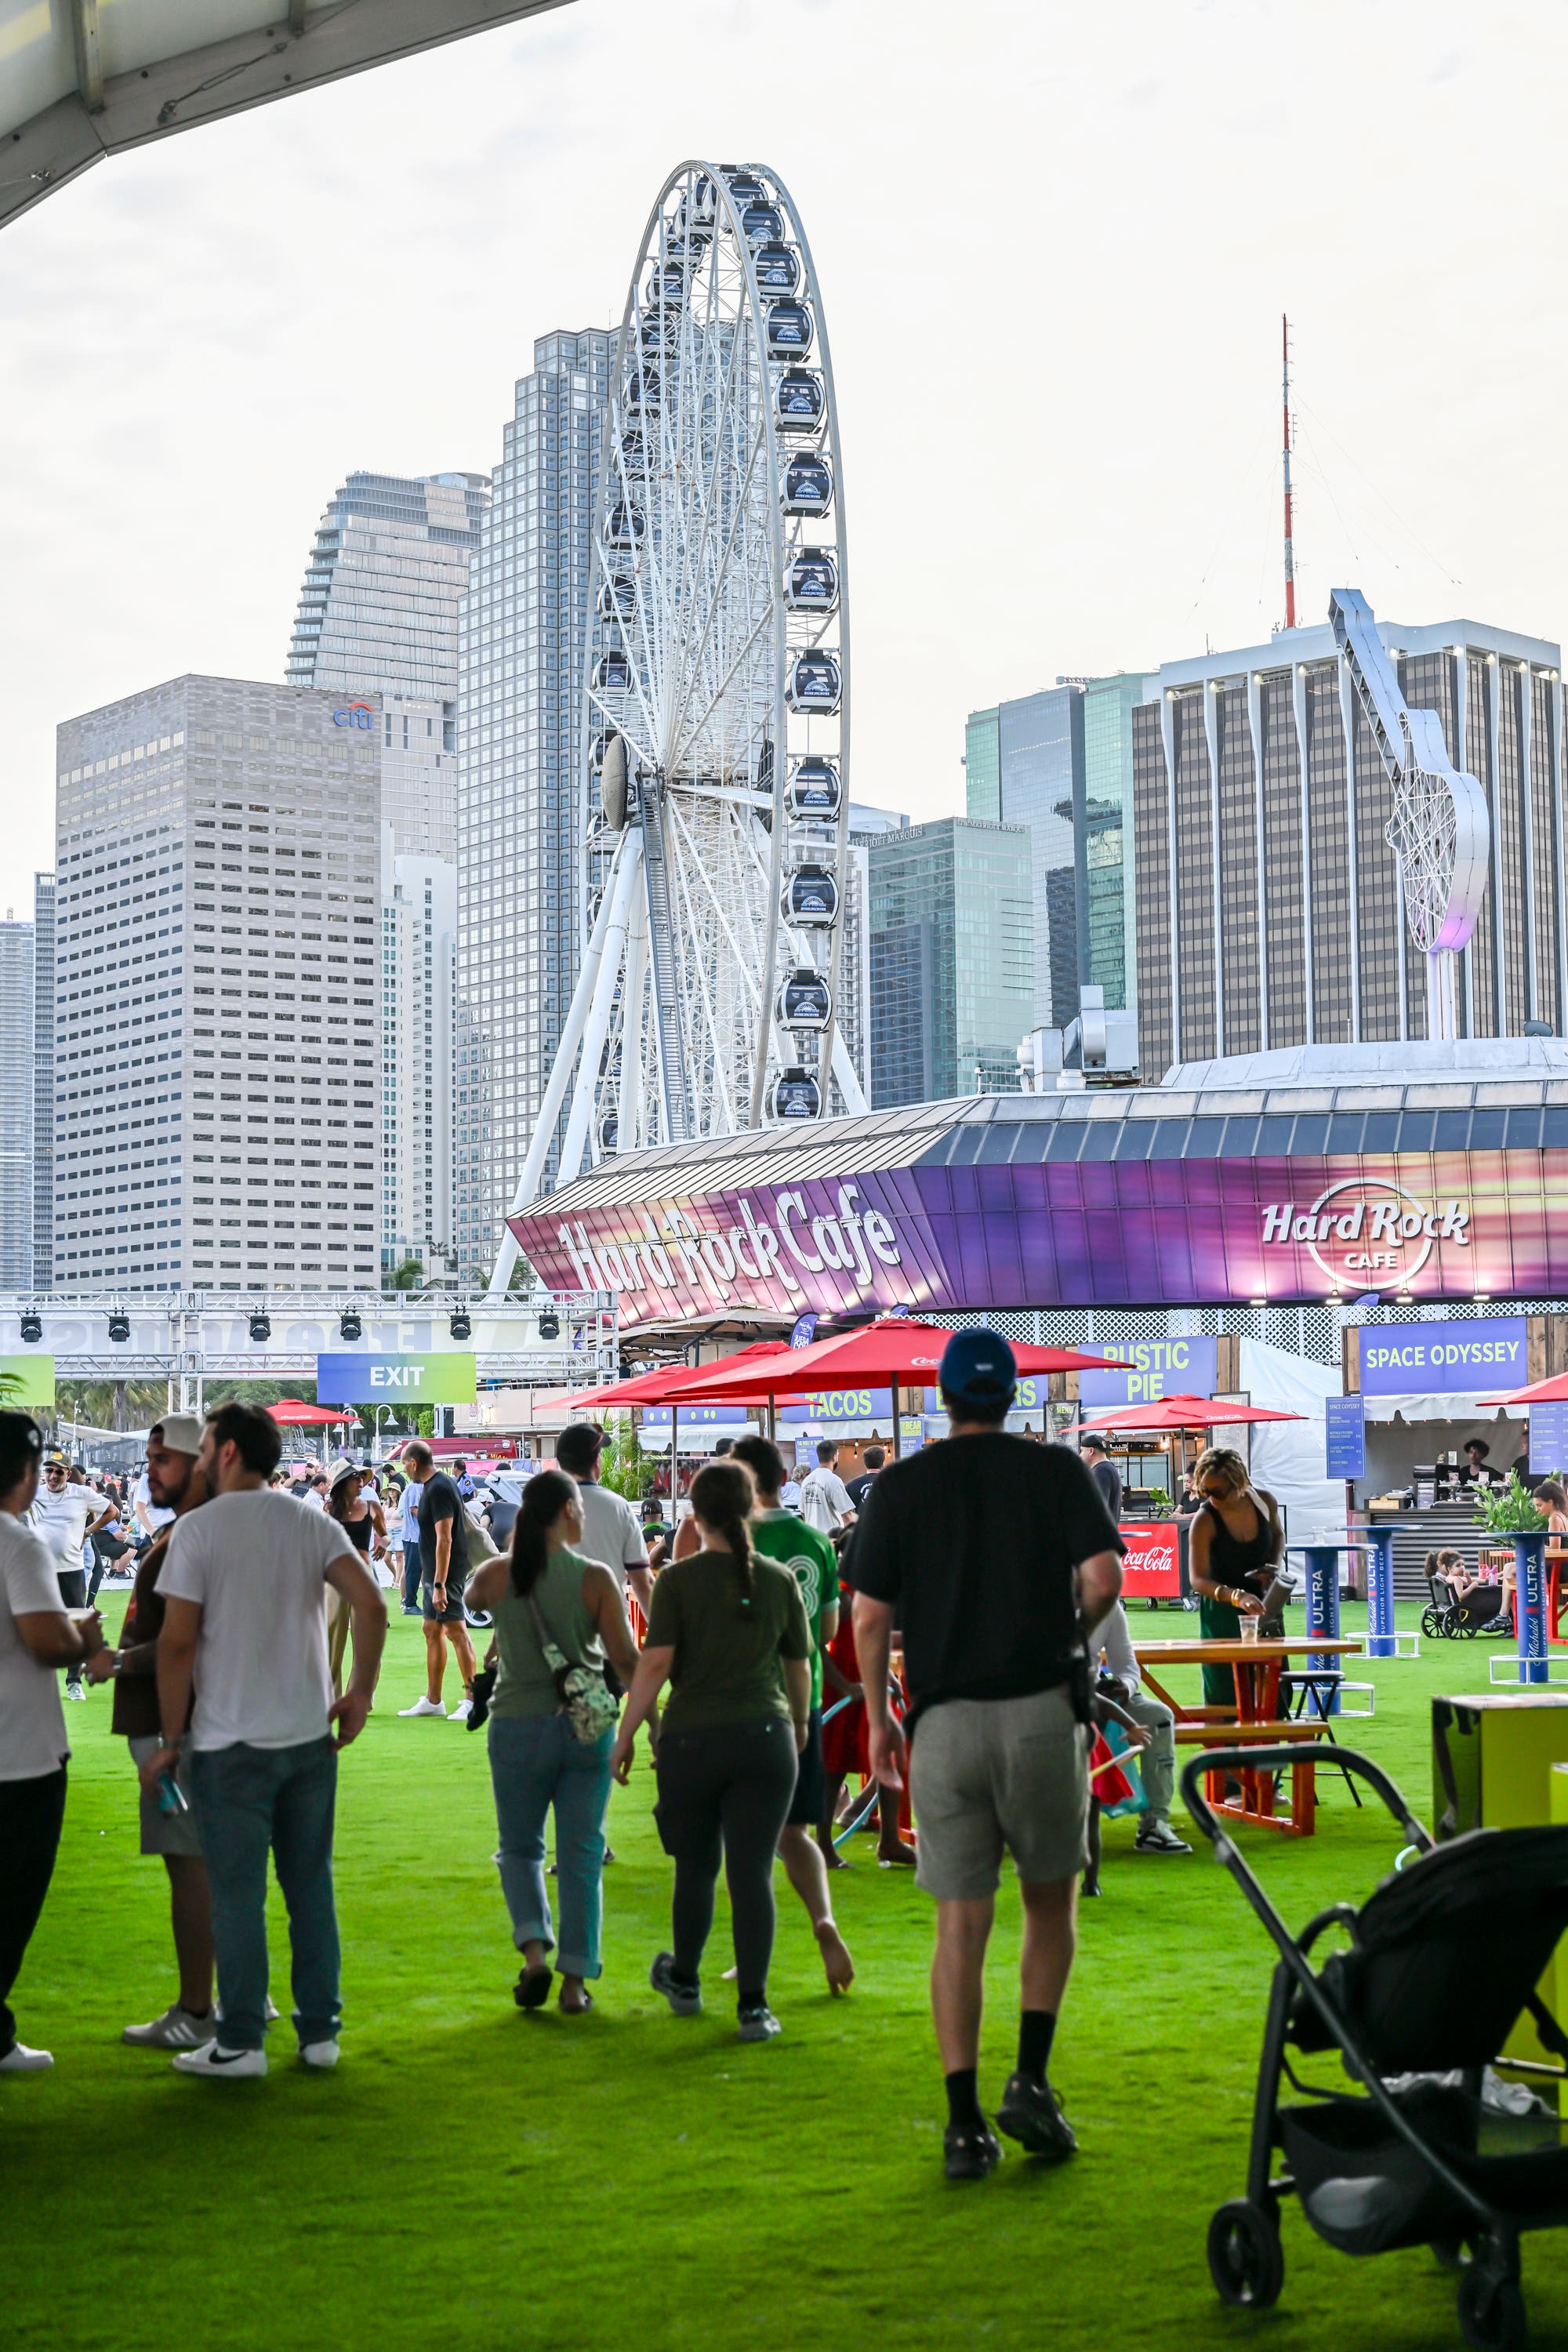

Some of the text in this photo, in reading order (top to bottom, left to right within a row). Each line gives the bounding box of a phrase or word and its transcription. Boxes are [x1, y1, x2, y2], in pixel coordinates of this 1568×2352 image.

[333, 707, 372, 729] citi
[887, 827, 923, 844] MARQUIS
[1262, 1200, 1469, 1247] Hard Rock
[557, 1185, 902, 1301] Hard Rock Cafe
[1344, 1253, 1398, 1269] CAFE
[1103, 1341, 1189, 1372] RUSTIC
[1367, 1341, 1519, 1368] SPACE ODYSSEY
[369, 1367, 425, 1387] EXIT
[1127, 1373, 1164, 1402] PIE
[804, 1390, 873, 1417] TACOS
[1312, 1570, 1323, 1624] ULTRA
[1526, 1554, 1541, 1667] Michelob ULTRA
